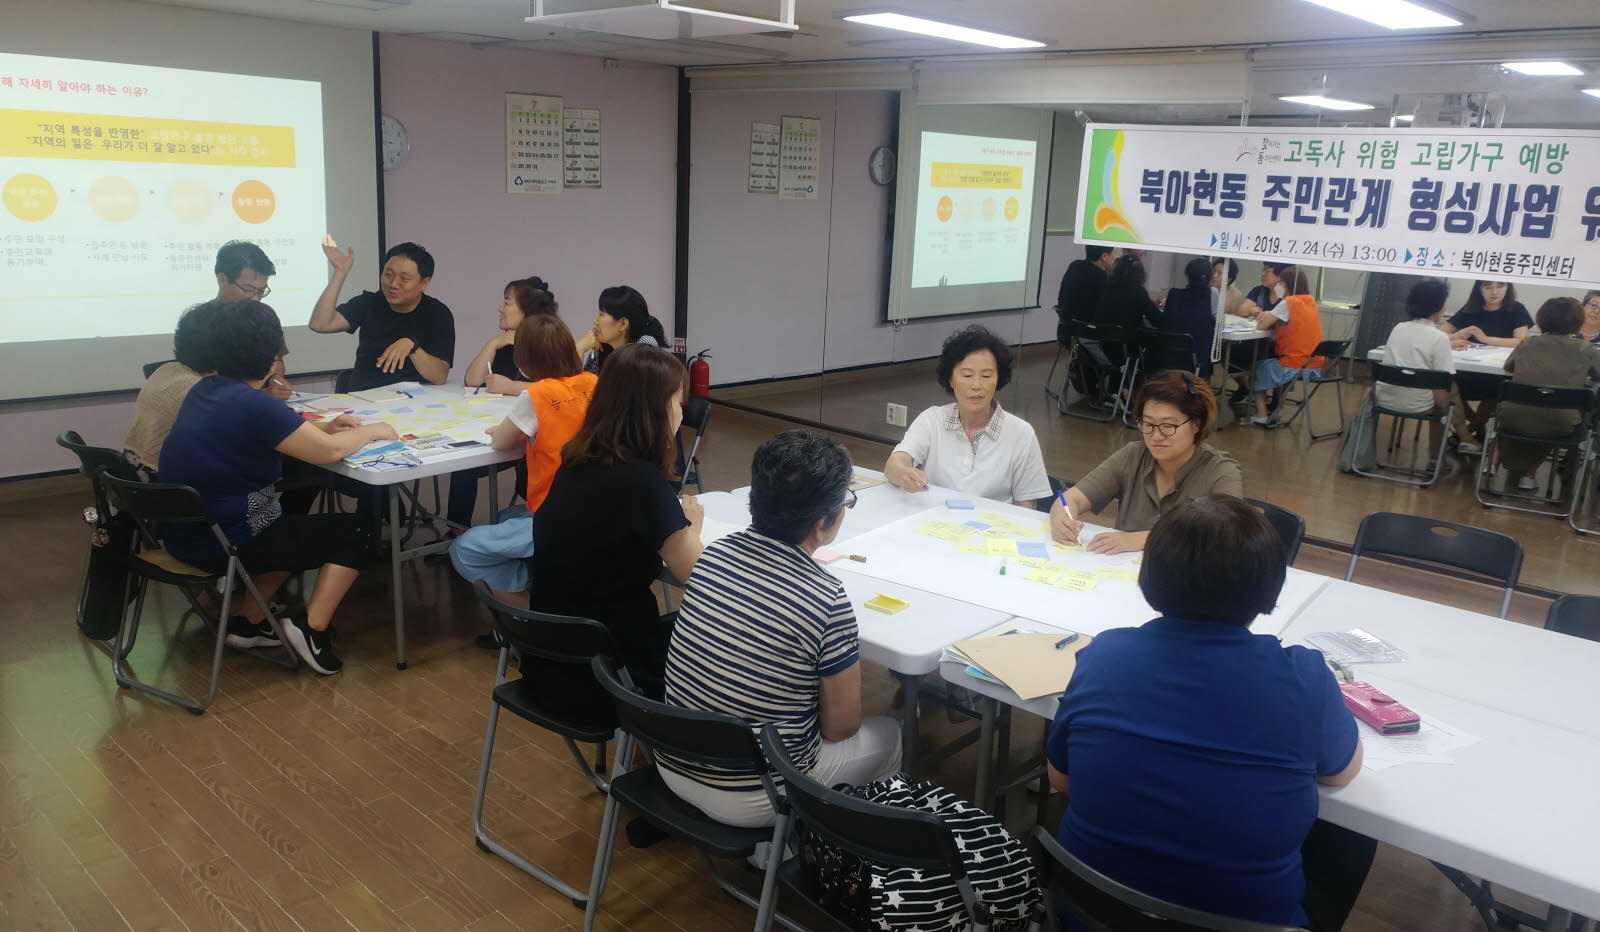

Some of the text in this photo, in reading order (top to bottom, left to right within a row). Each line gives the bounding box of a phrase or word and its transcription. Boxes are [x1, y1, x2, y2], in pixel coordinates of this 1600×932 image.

[18, 78, 52, 91] 자세히
[57, 81, 91, 93] 알아야
[96, 83, 118, 96] 하는
[122, 86, 149, 97] 이유?
[71, 125, 104, 138] 특성을
[71, 138, 93, 150] 일은
[102, 139, 134, 152] 우리가
[138, 141, 148, 152] 더
[152, 142, 162, 153] 잘
[166, 142, 186, 154] 알고
[1283, 140, 1569, 175] 고독사 위험 고립가구 예방
[1140, 168, 1247, 219] 북아현동
[1261, 174, 1392, 229] 주민관계
[1407, 176, 1561, 239] 형성사업
[1254, 235, 1283, 254] 2019.
[1302, 240, 1319, 256] 24
[1351, 245, 1397, 262] 13:00
[1461, 250, 1576, 279] 북아현동주민센터
